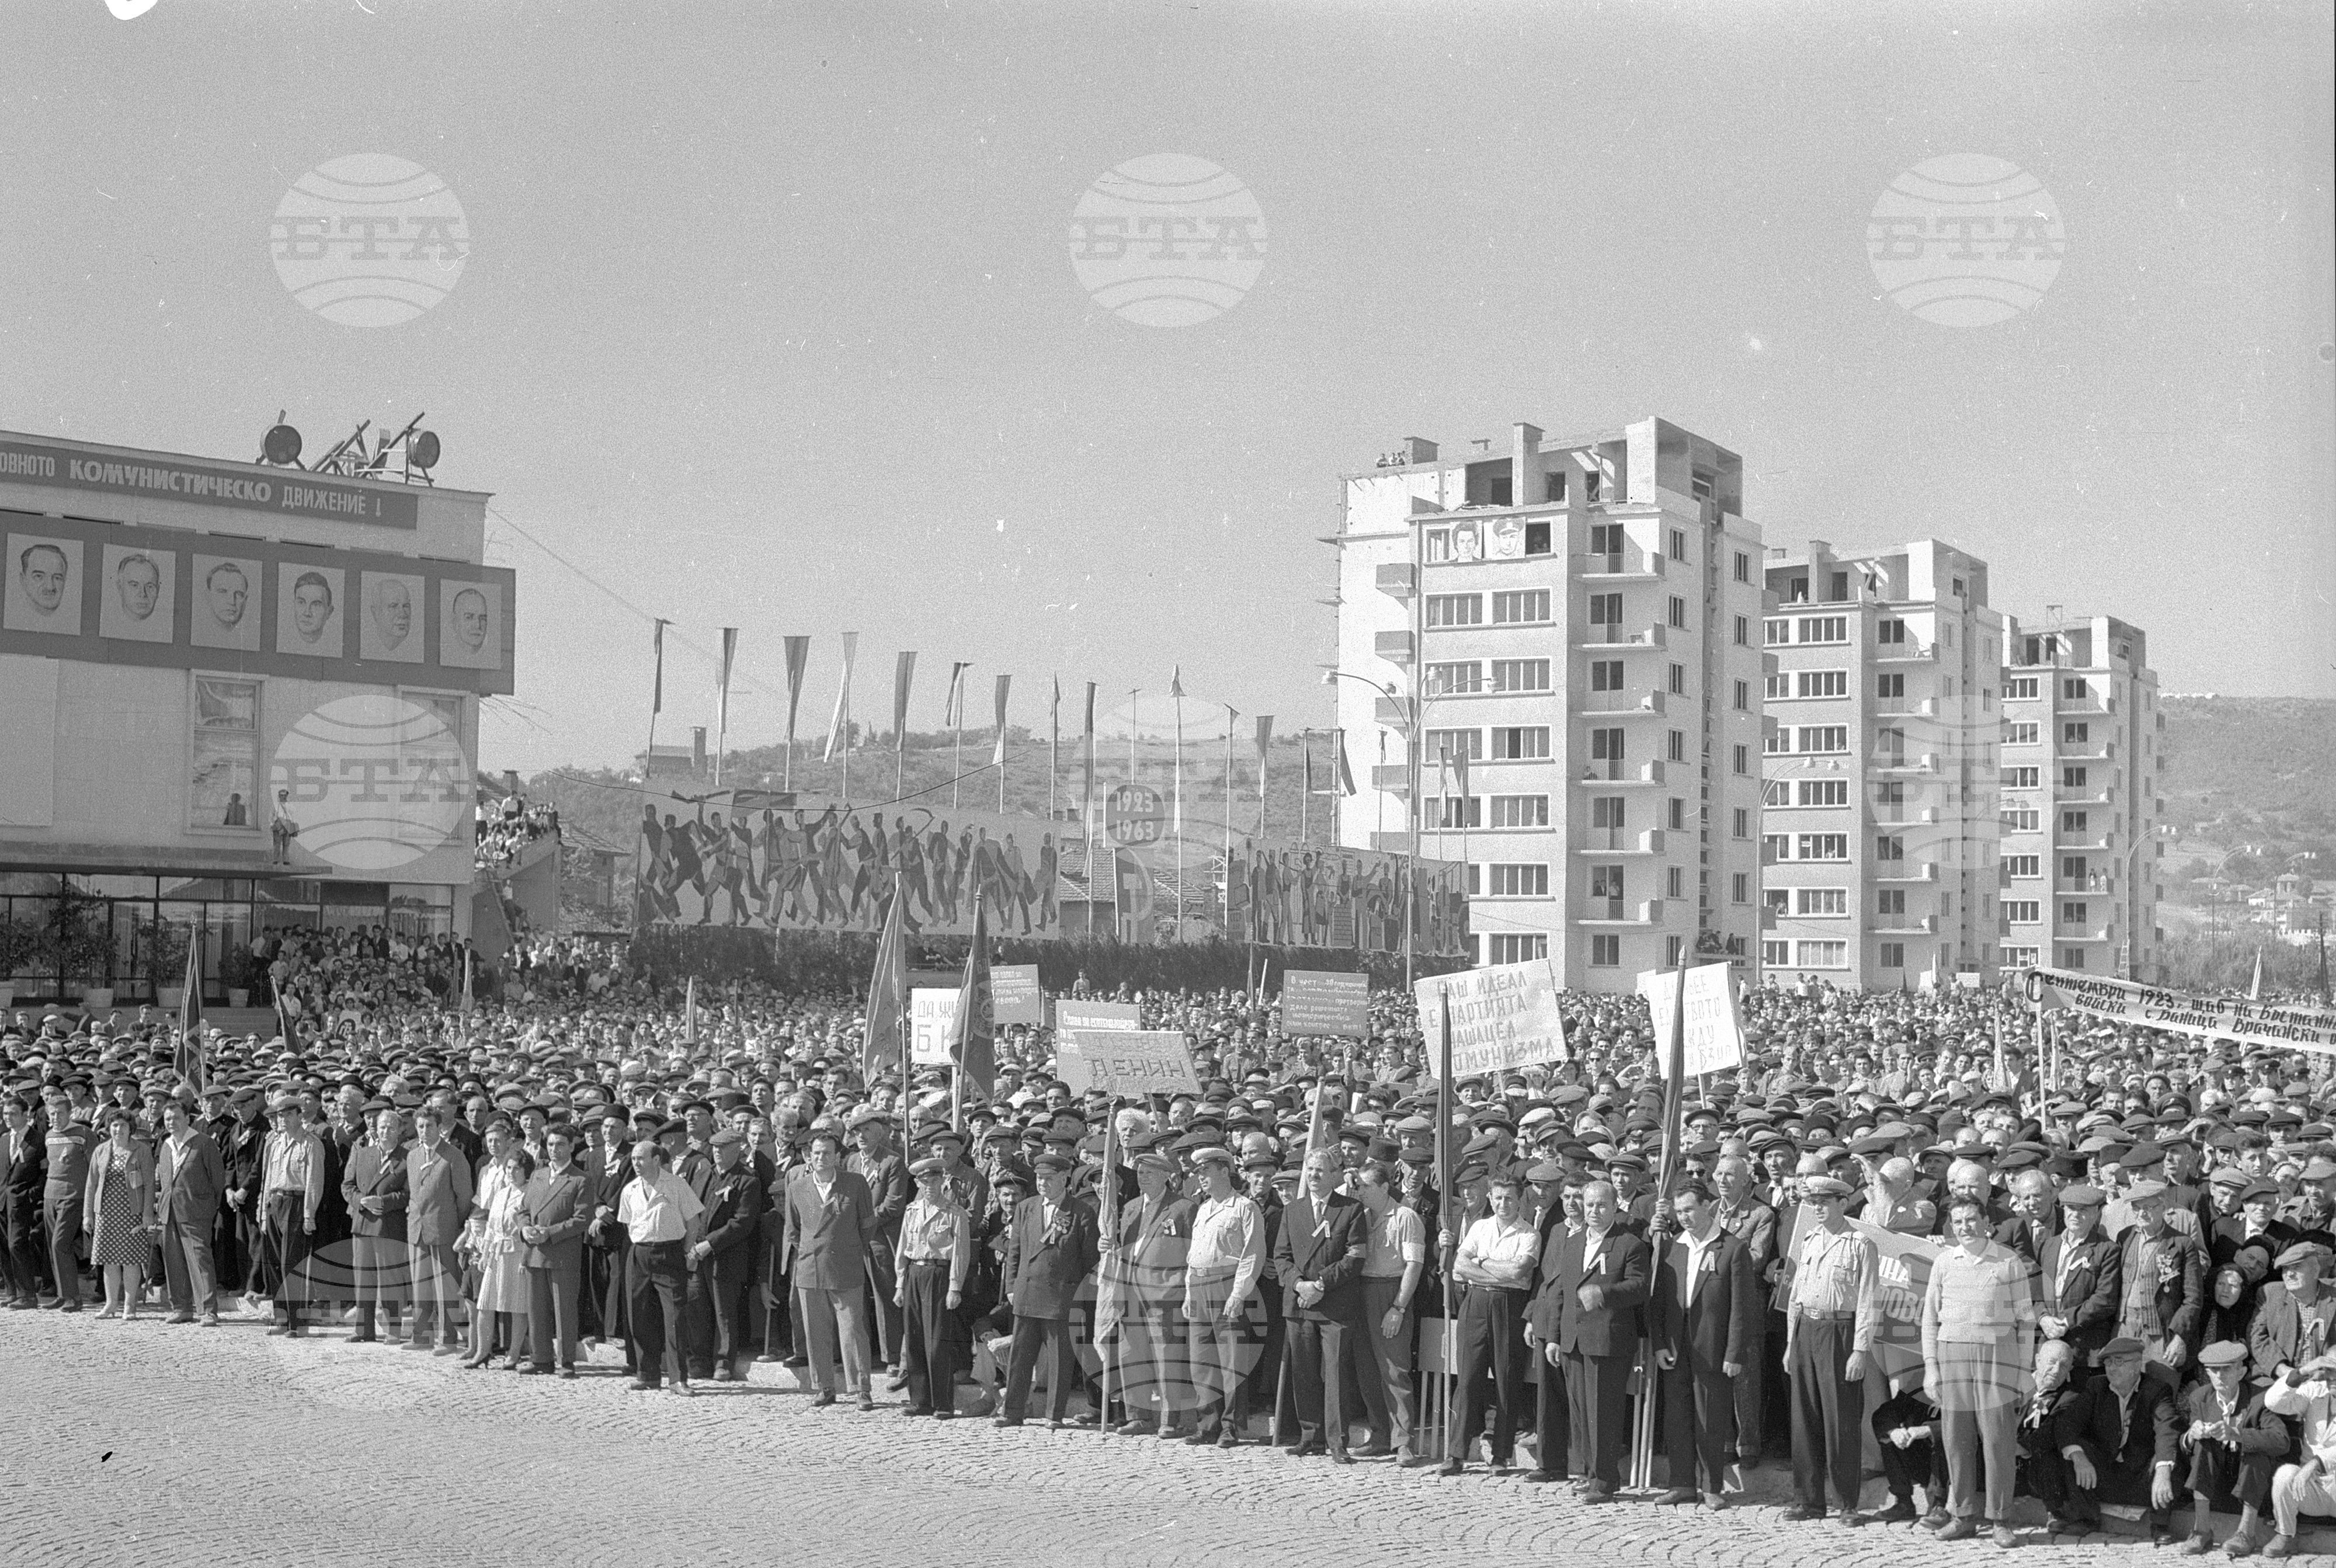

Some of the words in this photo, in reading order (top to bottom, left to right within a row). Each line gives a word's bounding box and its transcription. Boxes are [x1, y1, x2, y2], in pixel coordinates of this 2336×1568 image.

[69, 458, 272, 502] КОМУНИСТИЧЕСКО
[282, 485, 366, 515] ДВИЖЕНИЕ
[1116, 791, 1154, 812] 1923
[1116, 819, 1155, 840] 1963
[917, 1000, 934, 1018] ДА
[2139, 989, 2174, 1009] 1923
[2192, 999, 2232, 1014] щаб
[2234, 1003, 2252, 1018] на
[2074, 994, 2126, 1014] войски
[2156, 1009, 2218, 1030] Баница
[2231, 1018, 2320, 1043] Врачански
[1091, 1058, 1186, 1077] ЛЕНИН
